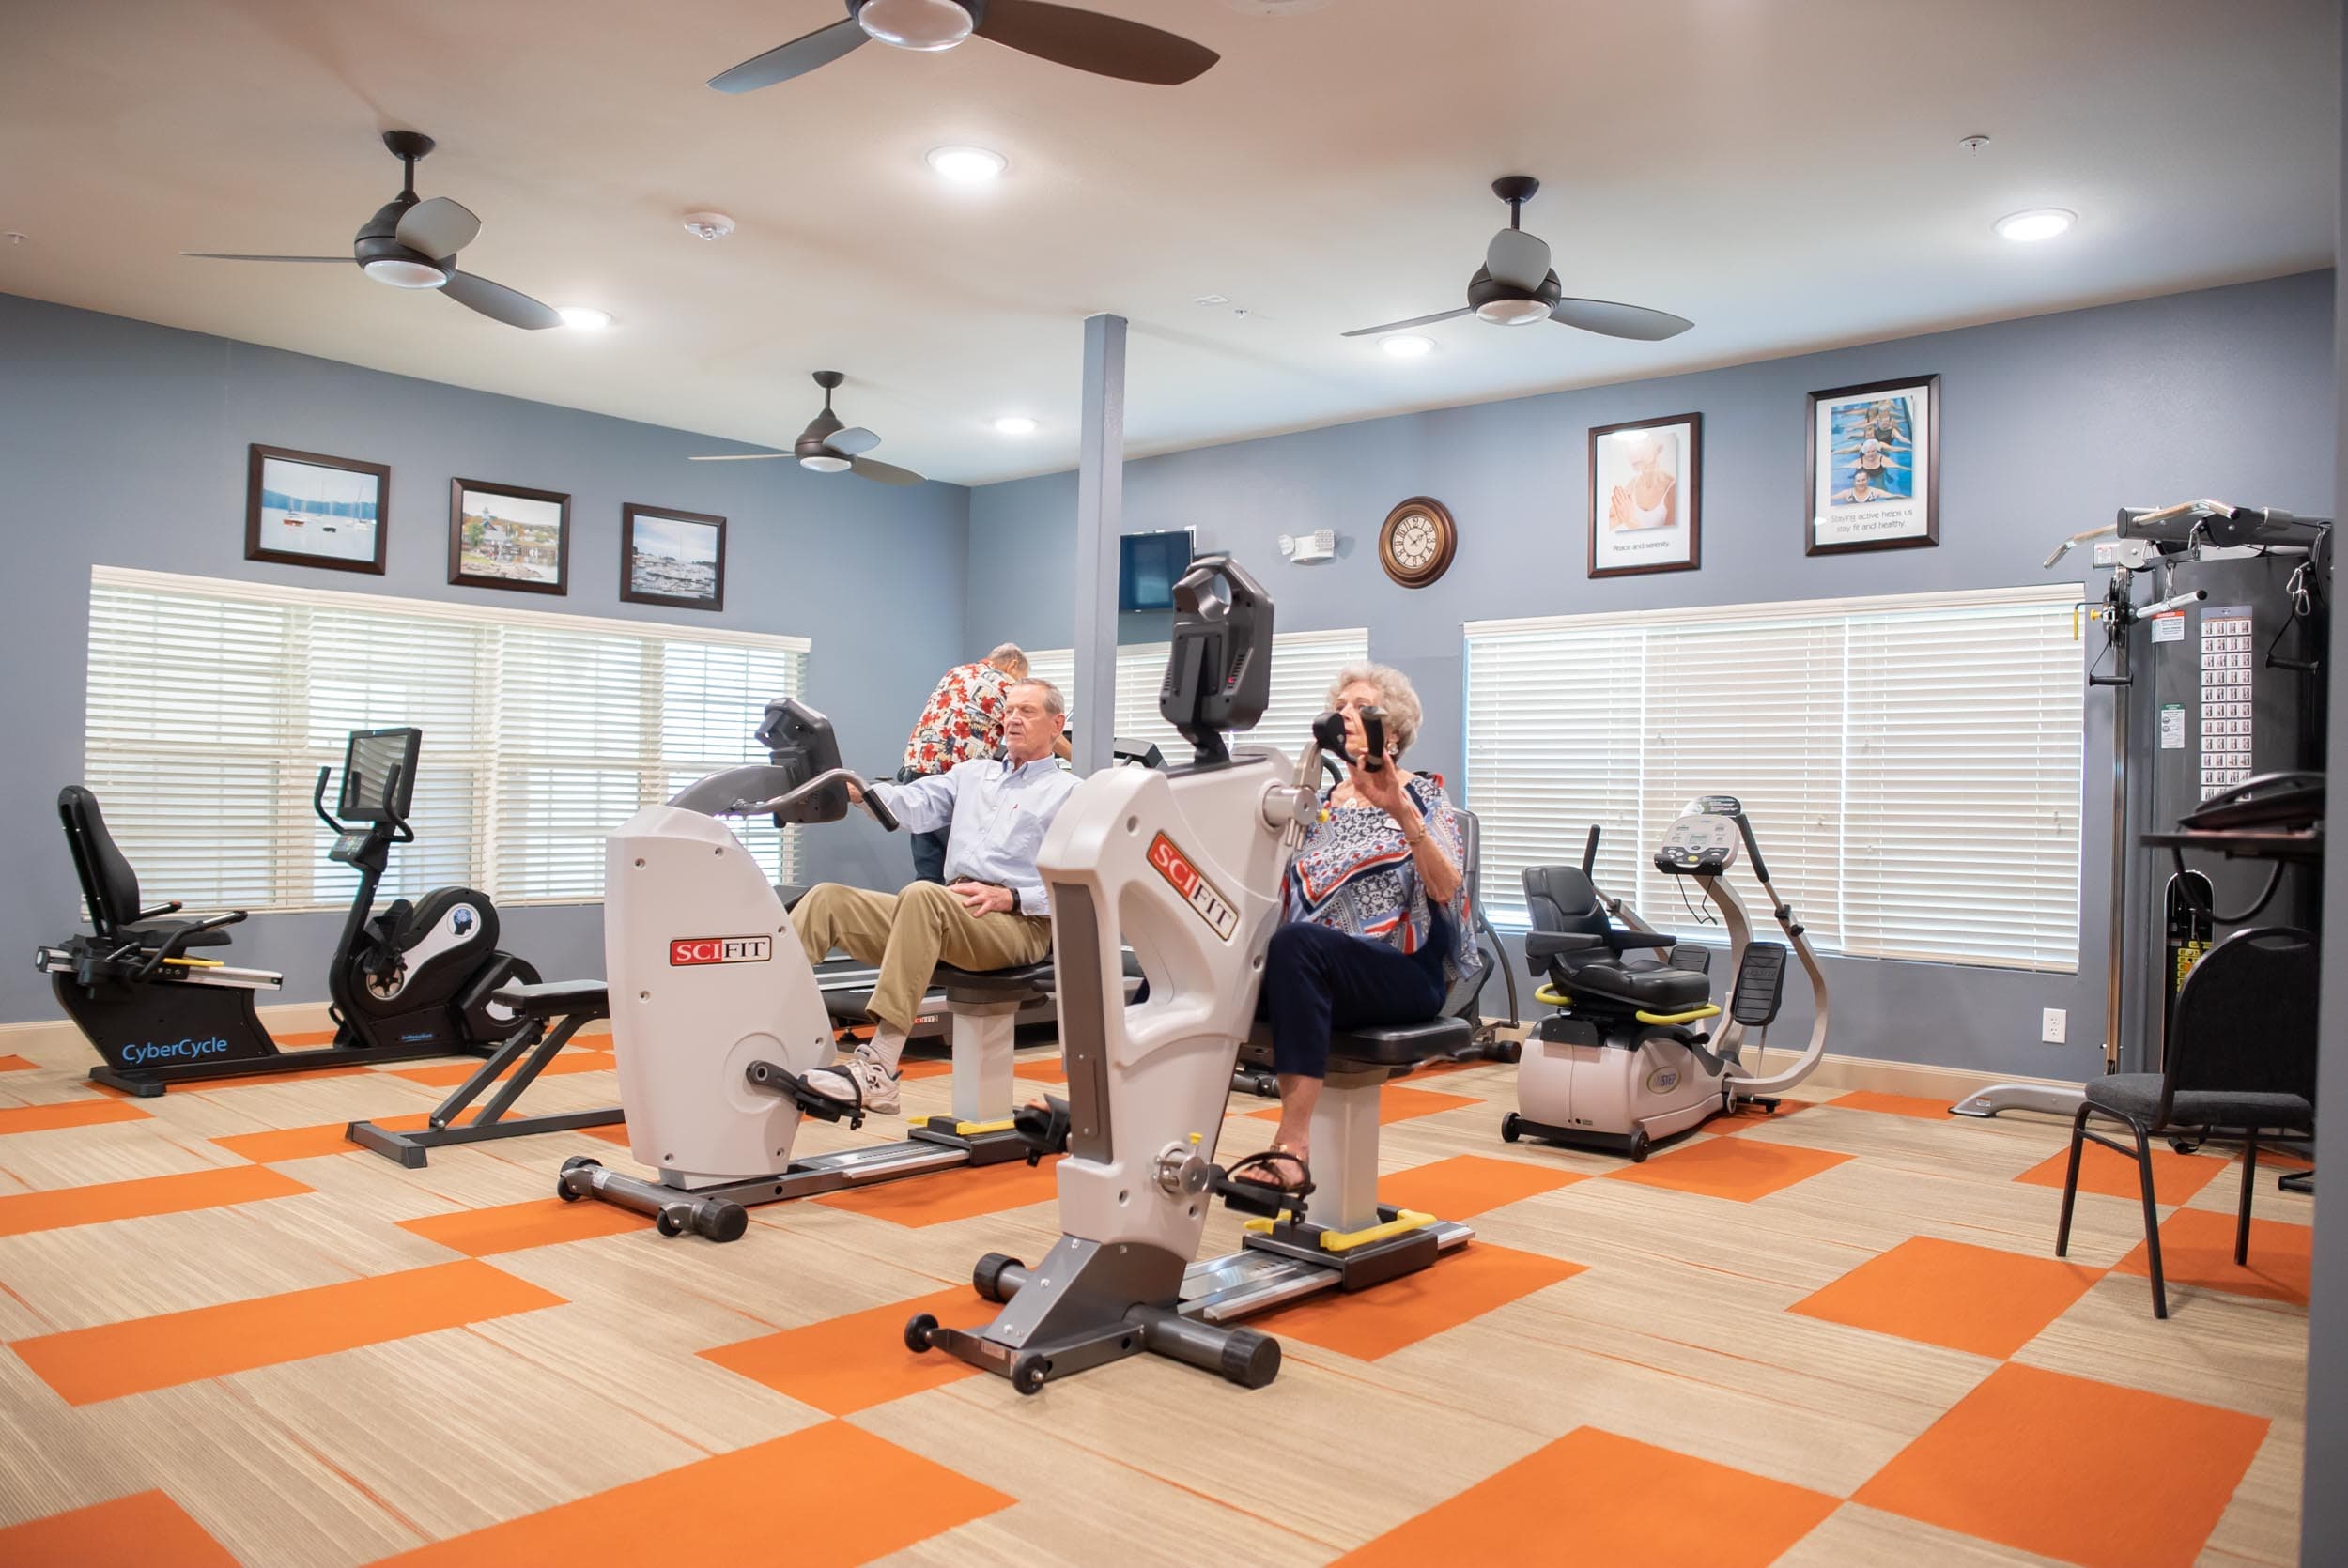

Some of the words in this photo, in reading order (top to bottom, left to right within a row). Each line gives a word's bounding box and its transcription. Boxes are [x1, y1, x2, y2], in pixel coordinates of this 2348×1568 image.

[1859, 510, 1879, 520] active
[1881, 509, 1902, 518] helps
[1836, 524, 1851, 533] stay
[1861, 522, 1877, 530] and
[1154, 843, 1232, 927] SCIFIT
[676, 941, 765, 961] SCIFIT
[121, 1036, 228, 1064] CyberCycle
